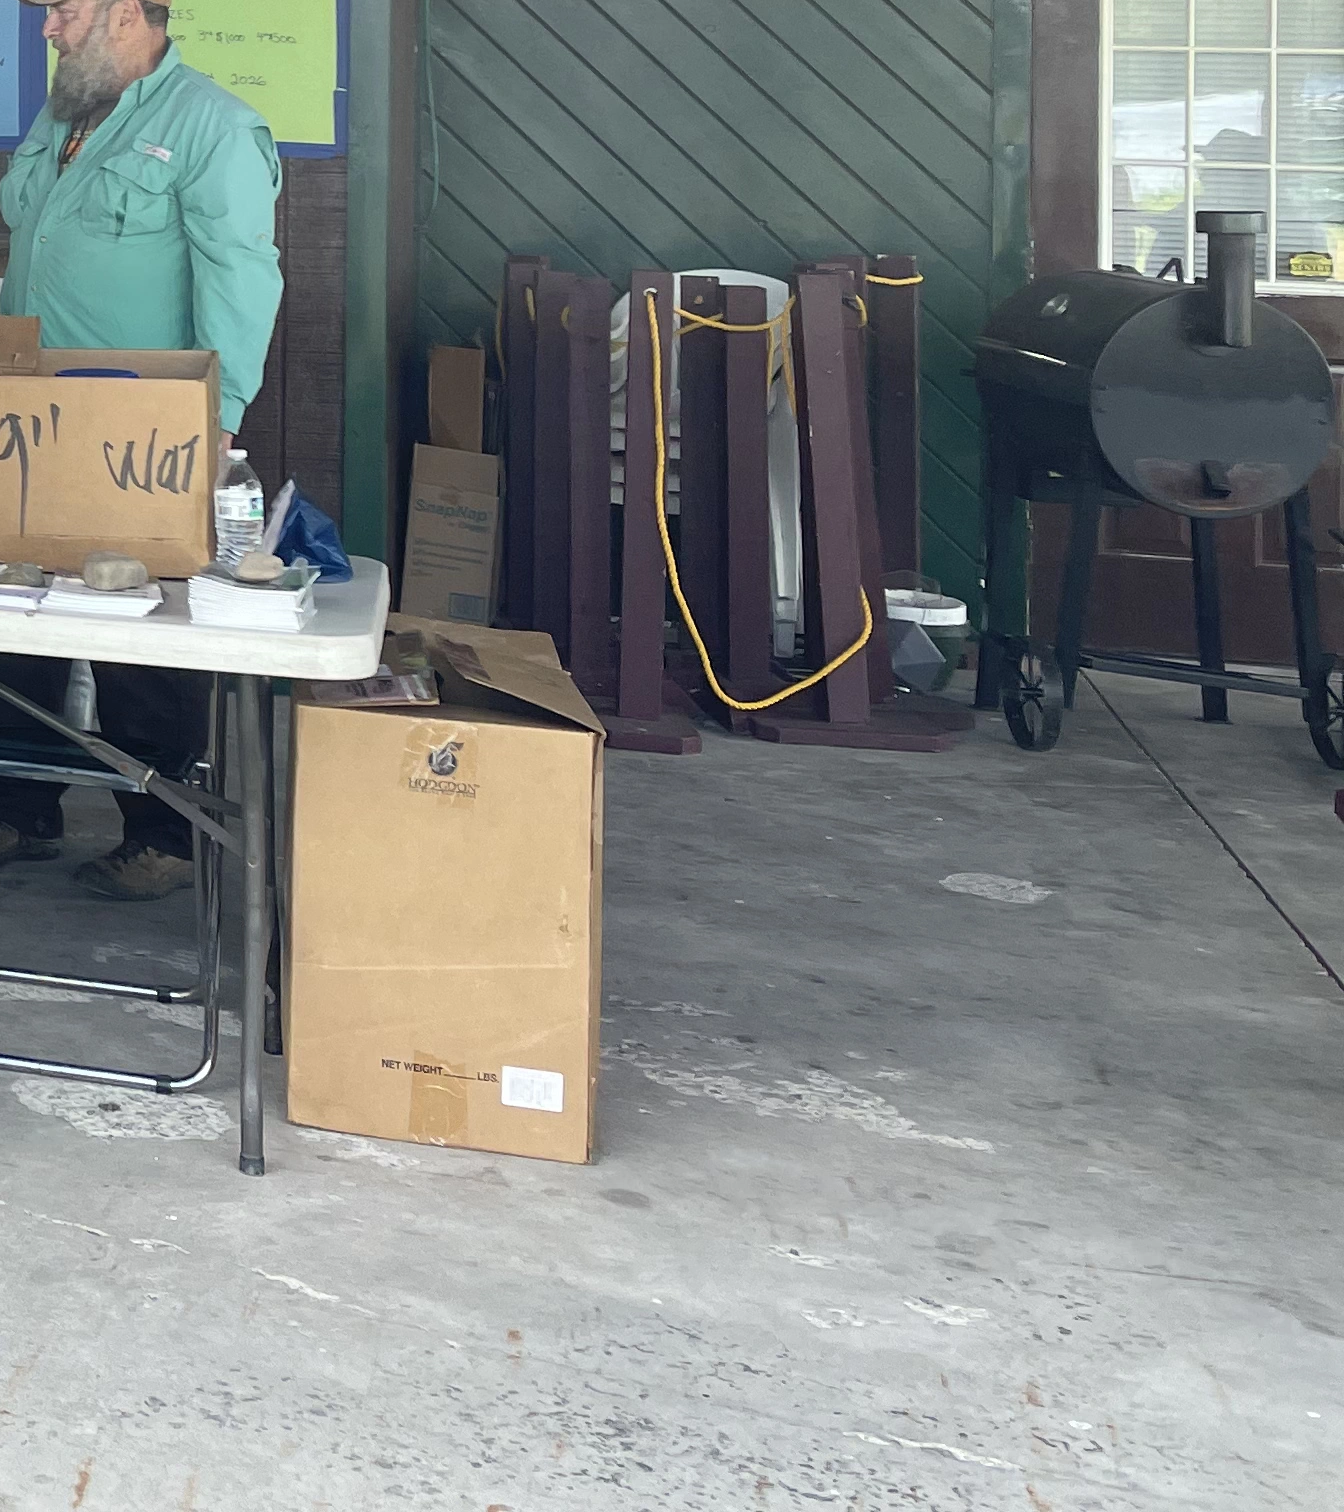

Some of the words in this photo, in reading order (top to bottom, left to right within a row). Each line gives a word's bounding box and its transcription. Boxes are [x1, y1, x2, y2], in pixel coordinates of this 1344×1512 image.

[230, 73, 267, 86] 2026
[381, 1059, 402, 1070] NET
[404, 1061, 444, 1076] WEIGHT
